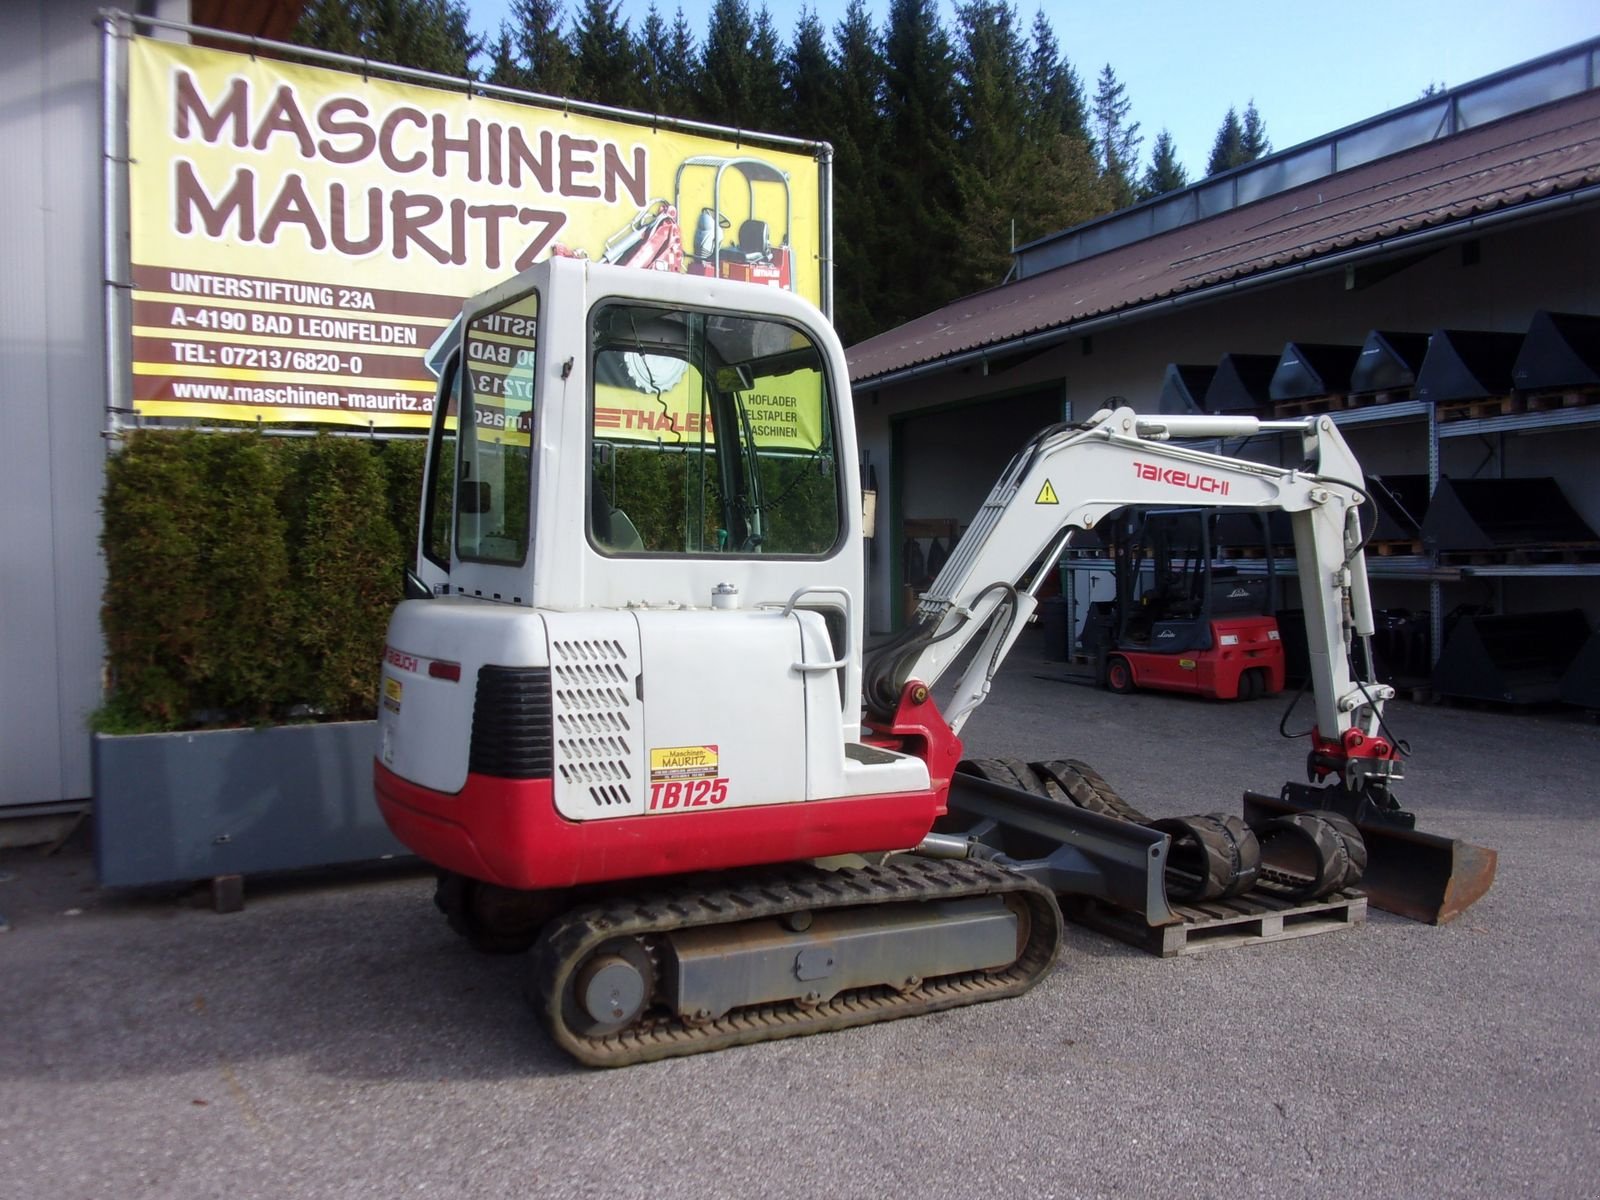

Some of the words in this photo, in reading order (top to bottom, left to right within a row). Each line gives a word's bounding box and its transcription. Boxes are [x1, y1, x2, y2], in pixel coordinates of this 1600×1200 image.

[174, 70, 647, 207] MASCHINEN
[174, 160, 567, 273] MAURITZ
[170, 271, 333, 306] UNTERSTIFTUNG
[338, 290, 376, 310] 23A
[170, 306, 247, 331] A-4190
[251, 313, 293, 335] BAD
[298, 318, 417, 345] LEONFELDEN
[171, 342, 216, 363] TEL:
[220, 346, 363, 374] 07213/6820-0
[172, 383, 437, 412] www.maschinen-mauritz.a
[748, 394, 797, 407] HOFLADER
[662, 756, 706, 768] MAURITZ
[650, 777, 729, 810] TB125
